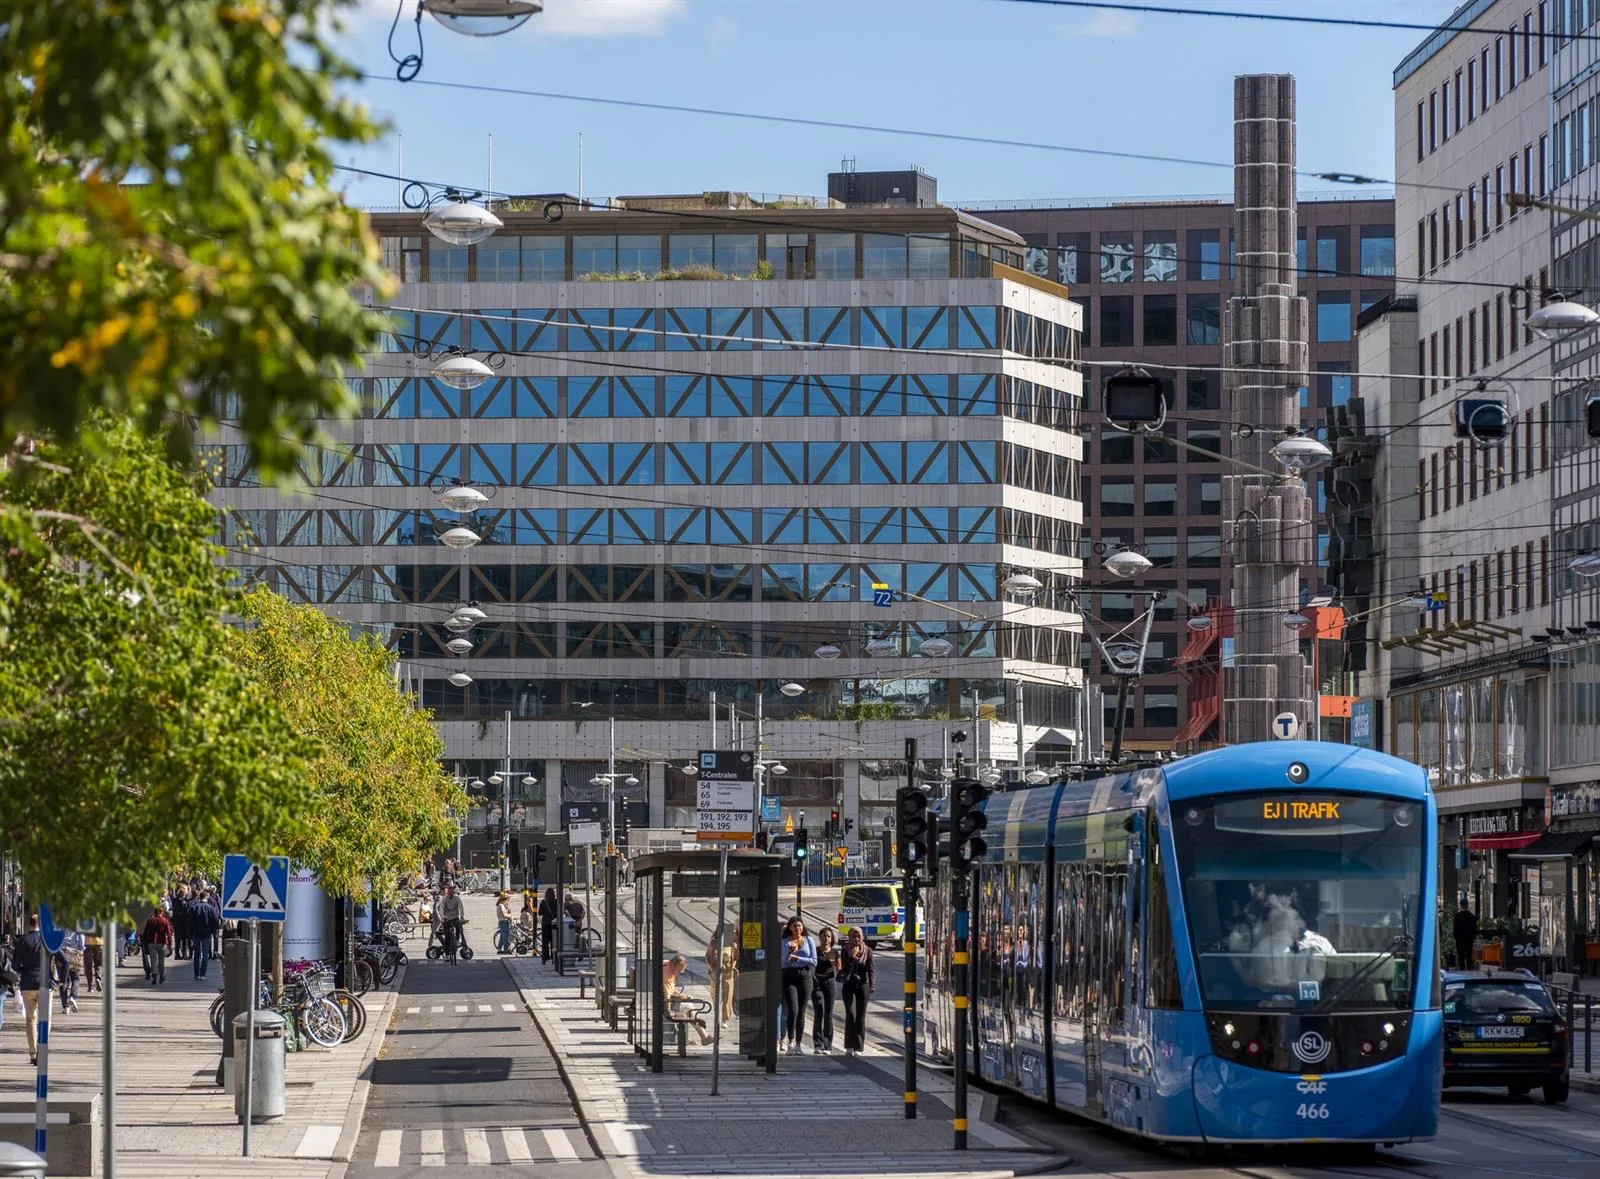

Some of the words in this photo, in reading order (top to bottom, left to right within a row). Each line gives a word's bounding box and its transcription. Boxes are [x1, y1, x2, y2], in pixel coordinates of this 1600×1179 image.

[875, 591, 891, 605] 72
[1277, 718, 1293, 736] T
[701, 771, 738, 779] T-Centralen
[700, 782, 711, 790] 54
[700, 791, 711, 799] 65
[700, 800, 711, 808] 69
[1263, 802, 1280, 819] EJ
[1283, 802, 1288, 819] I
[1291, 802, 1340, 819] TRAFIK
[700, 813, 715, 822] 191,
[734, 813, 748, 821] 193
[700, 822, 715, 830] 194,
[717, 822, 731, 830] 195
[1484, 1026, 1502, 1036] RKW
[1303, 1037, 1320, 1050] SL
[1296, 1103, 1329, 1119] 466
